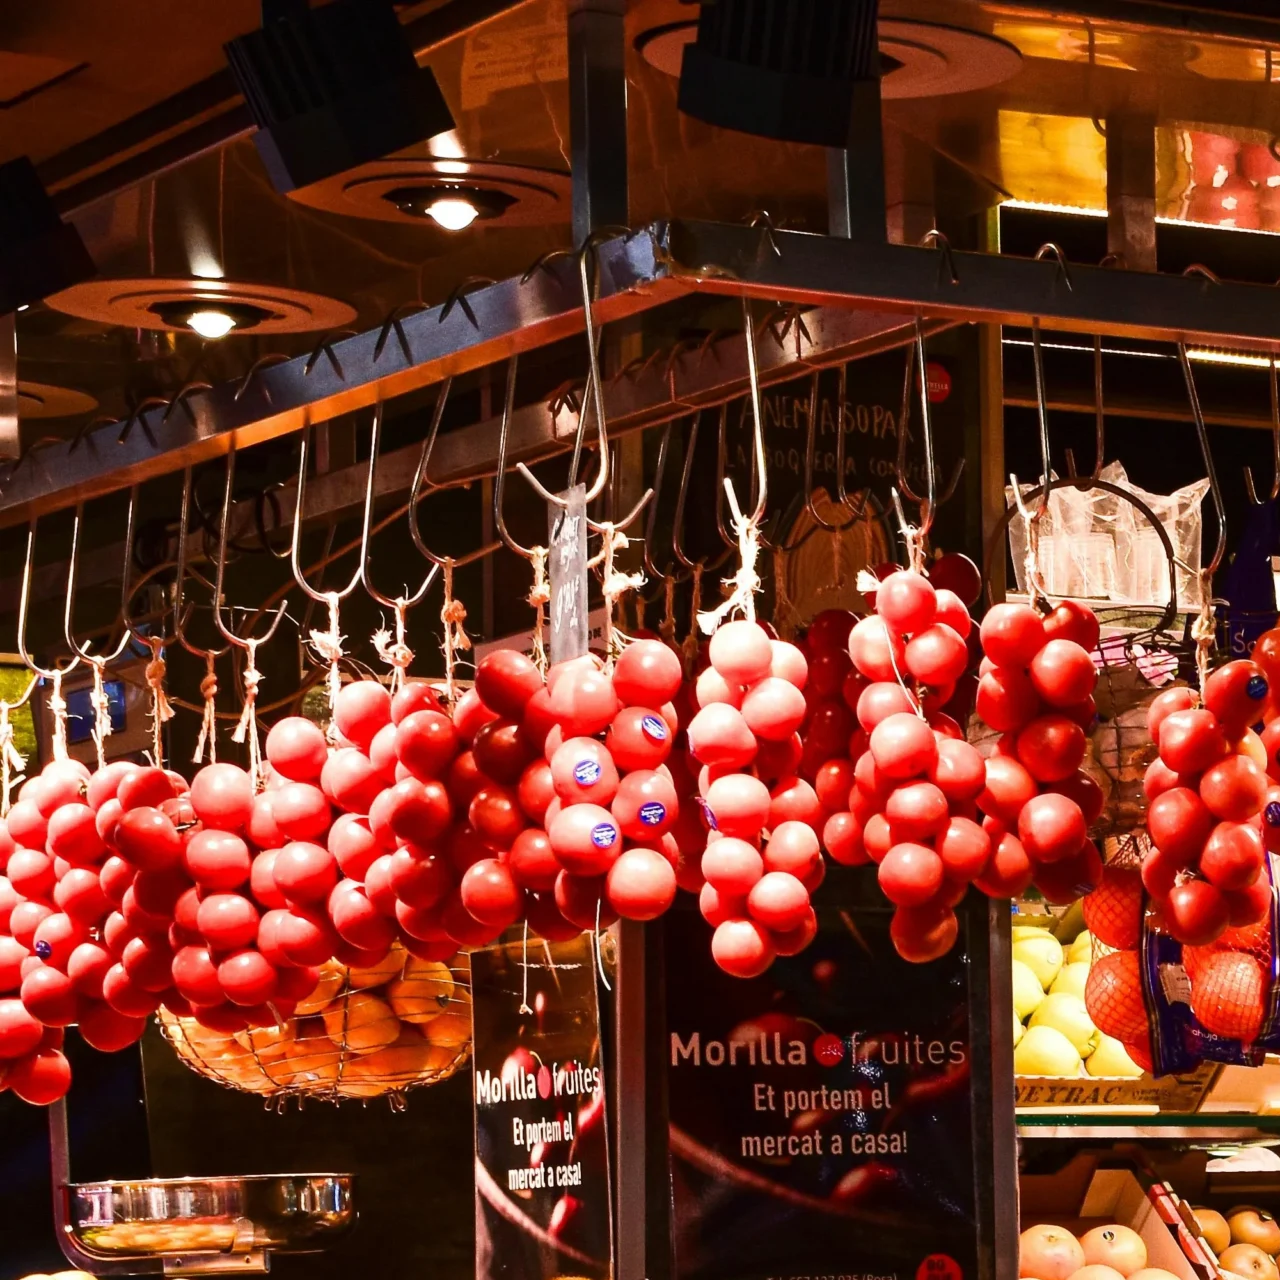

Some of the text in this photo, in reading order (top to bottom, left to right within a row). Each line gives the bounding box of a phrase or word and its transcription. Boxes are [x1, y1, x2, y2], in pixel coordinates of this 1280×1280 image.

[670, 1031, 966, 1066] Morilla fruites
[476, 1060, 600, 1104] Morilla fruites
[1015, 1086, 1122, 1104] NEYRAC
[754, 1082, 891, 1118] Et portem el
[513, 1112, 573, 1151] Et portem el
[741, 1130, 908, 1156] mercat a casa!
[508, 1162, 582, 1190] mercat a casa!
